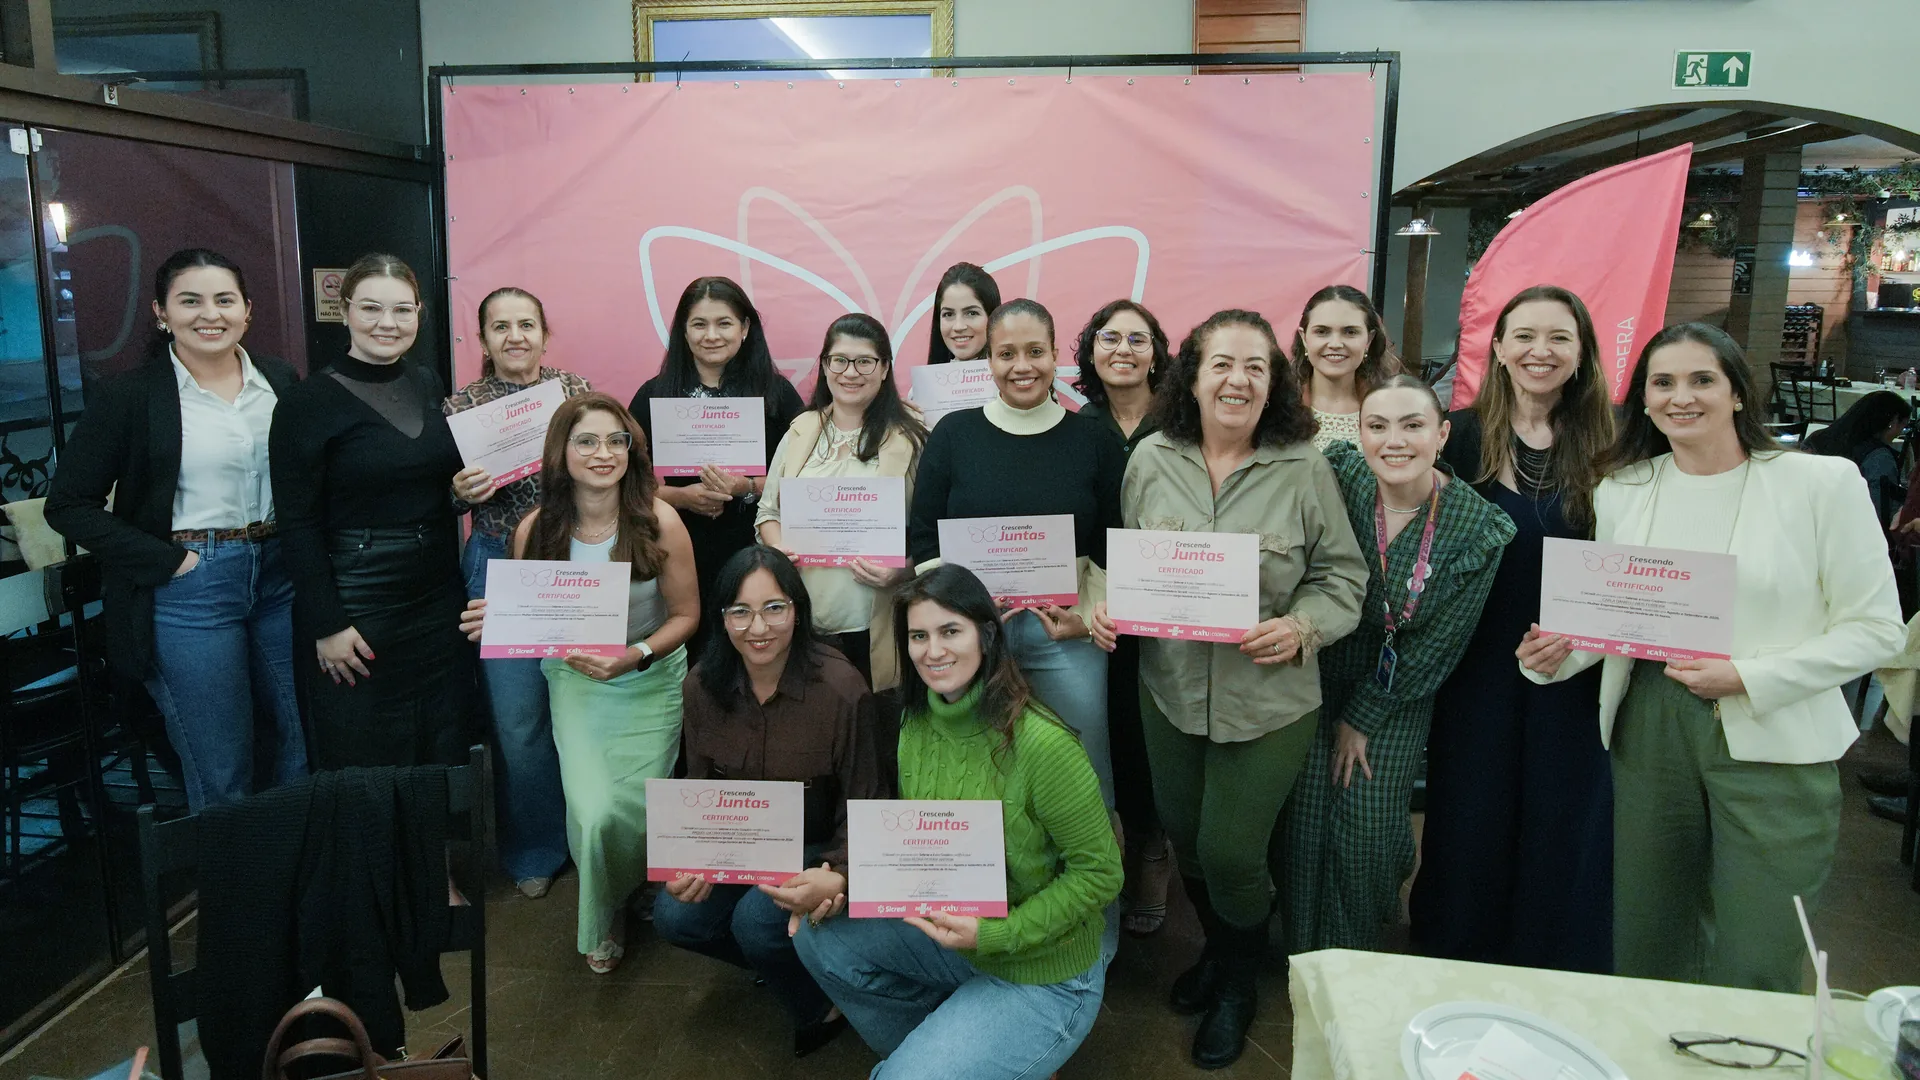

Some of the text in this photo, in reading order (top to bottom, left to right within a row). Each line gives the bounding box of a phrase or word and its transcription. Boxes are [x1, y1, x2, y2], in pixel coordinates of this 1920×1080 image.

[961, 373, 994, 383] Junta
[505, 397, 530, 409] Crescendo
[505, 400, 543, 420] Juntas
[701, 410, 740, 419] Juntas
[499, 418, 532, 433] CERTIFICADO
[835, 492, 878, 502] Juntas
[999, 531, 1045, 542] Juntas
[1172, 548, 1225, 562] Juntas
[1629, 555, 1674, 566] Crescendo
[1158, 567, 1204, 575] CERTIFICADO
[1624, 563, 1691, 581] Juntas
[551, 576, 600, 588] Juntas
[1606, 580, 1664, 593] CERTIFICADO
[1581, 640, 1605, 649] Sicredi
[1647, 649, 1668, 657] ICATU
[716, 796, 770, 809] Juntas
[916, 818, 969, 831] Juntas
